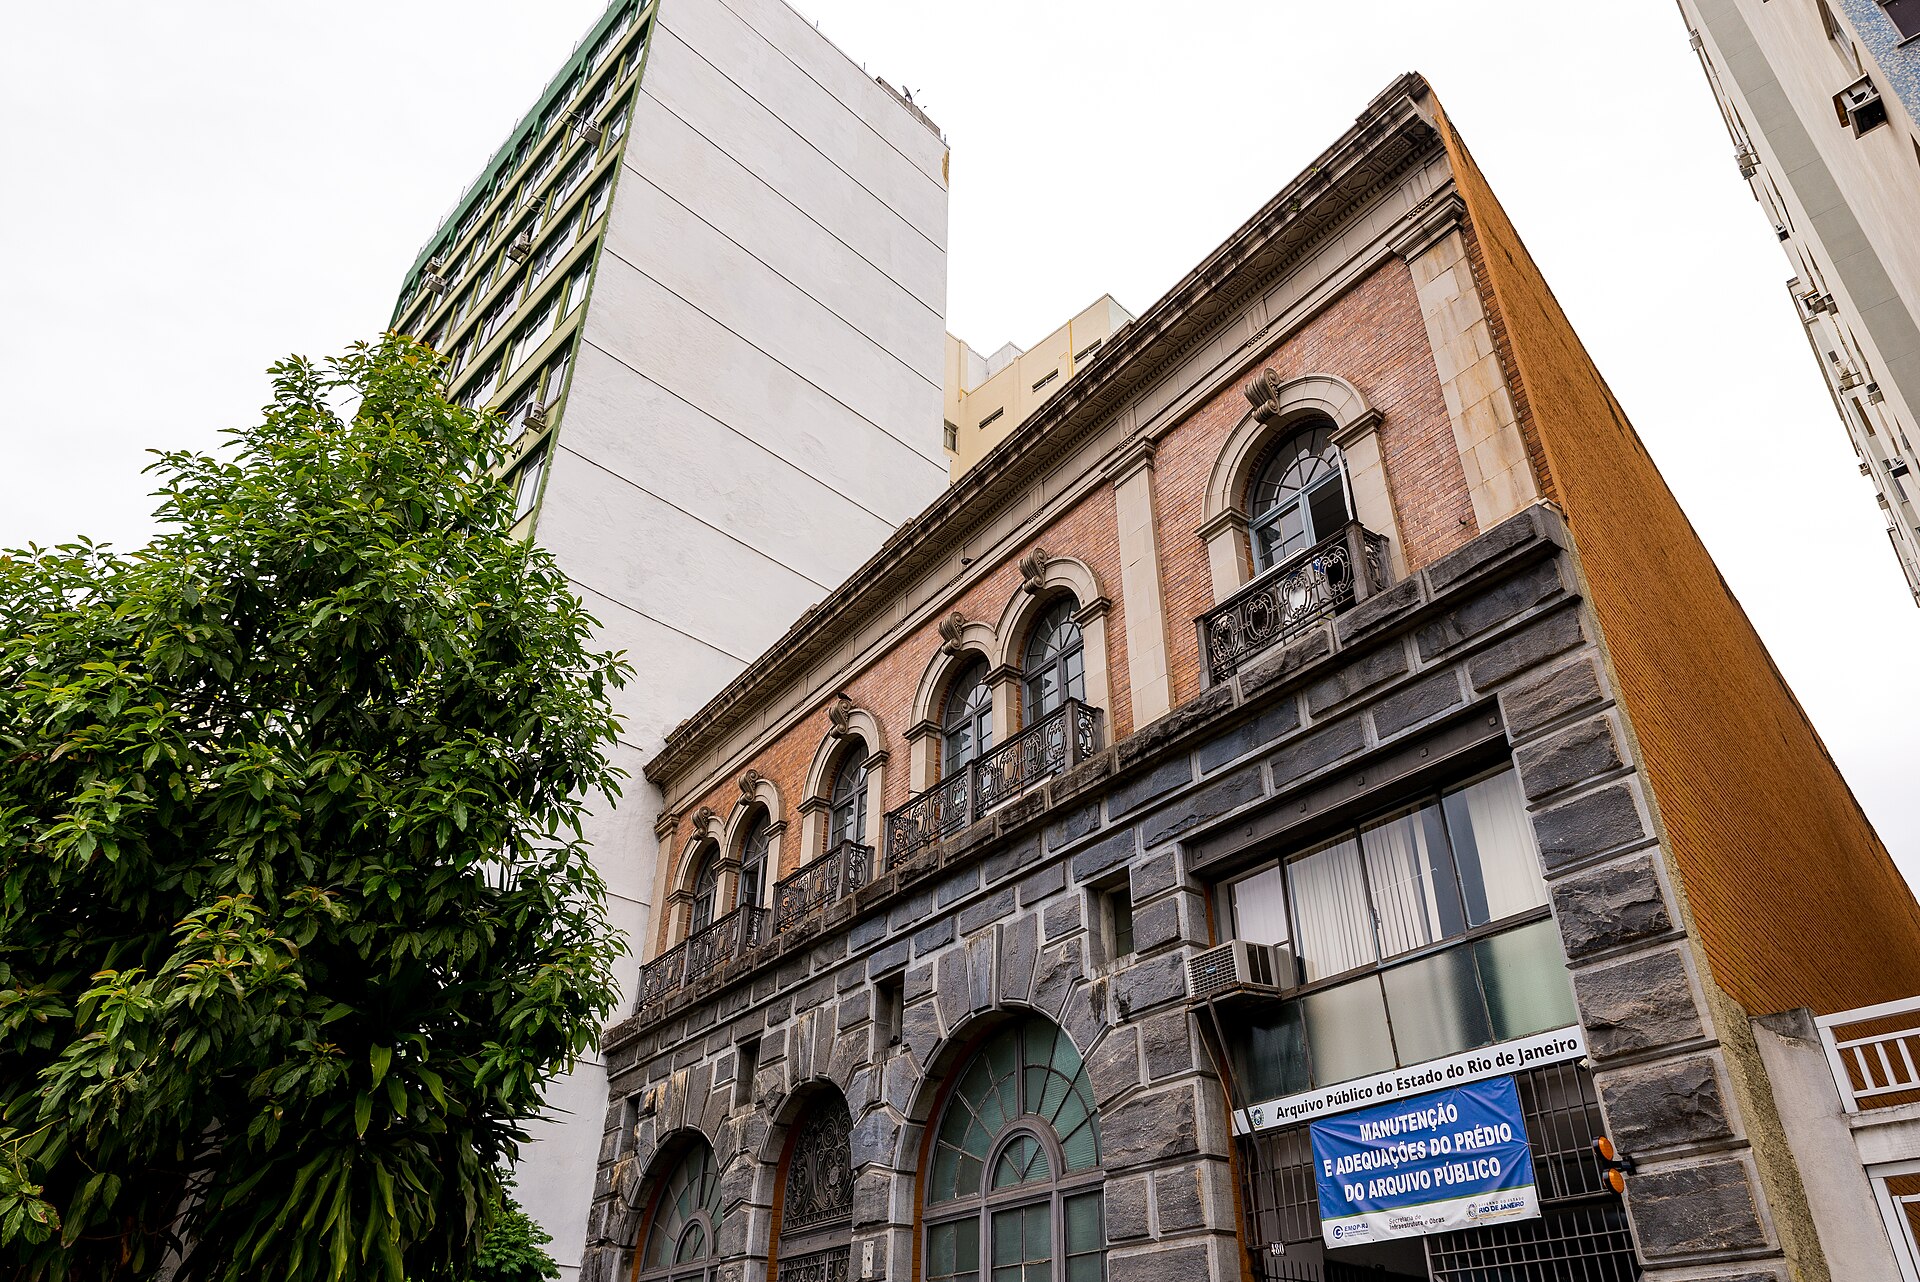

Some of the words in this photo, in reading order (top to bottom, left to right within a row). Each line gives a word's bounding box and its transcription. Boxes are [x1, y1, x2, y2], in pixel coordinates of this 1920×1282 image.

[1276, 1099, 1323, 1119] Arquivo
[1326, 1087, 1373, 1107] Público
[1376, 1081, 1393, 1096] do
[1396, 1064, 1443, 1090] Estado
[1446, 1062, 1464, 1078] do
[1467, 1057, 1492, 1073] Rio
[1495, 1052, 1515, 1067] de
[1518, 1038, 1577, 1066] Janeiro
[1359, 1102, 1458, 1142] MANUTENÇÃO
[1323, 1159, 1332, 1177] E
[1335, 1141, 1426, 1176] ADEQUAÇÕES
[1430, 1136, 1451, 1157] DO
[1454, 1122, 1512, 1152] PRÉDIO
[1344, 1182, 1364, 1202] DO
[1368, 1170, 1431, 1199] ARQUIVO
[1434, 1157, 1501, 1187] PÚBLICO
[1478, 1206, 1490, 1214] RIO
[1500, 1201, 1524, 1210] JANEIRO
